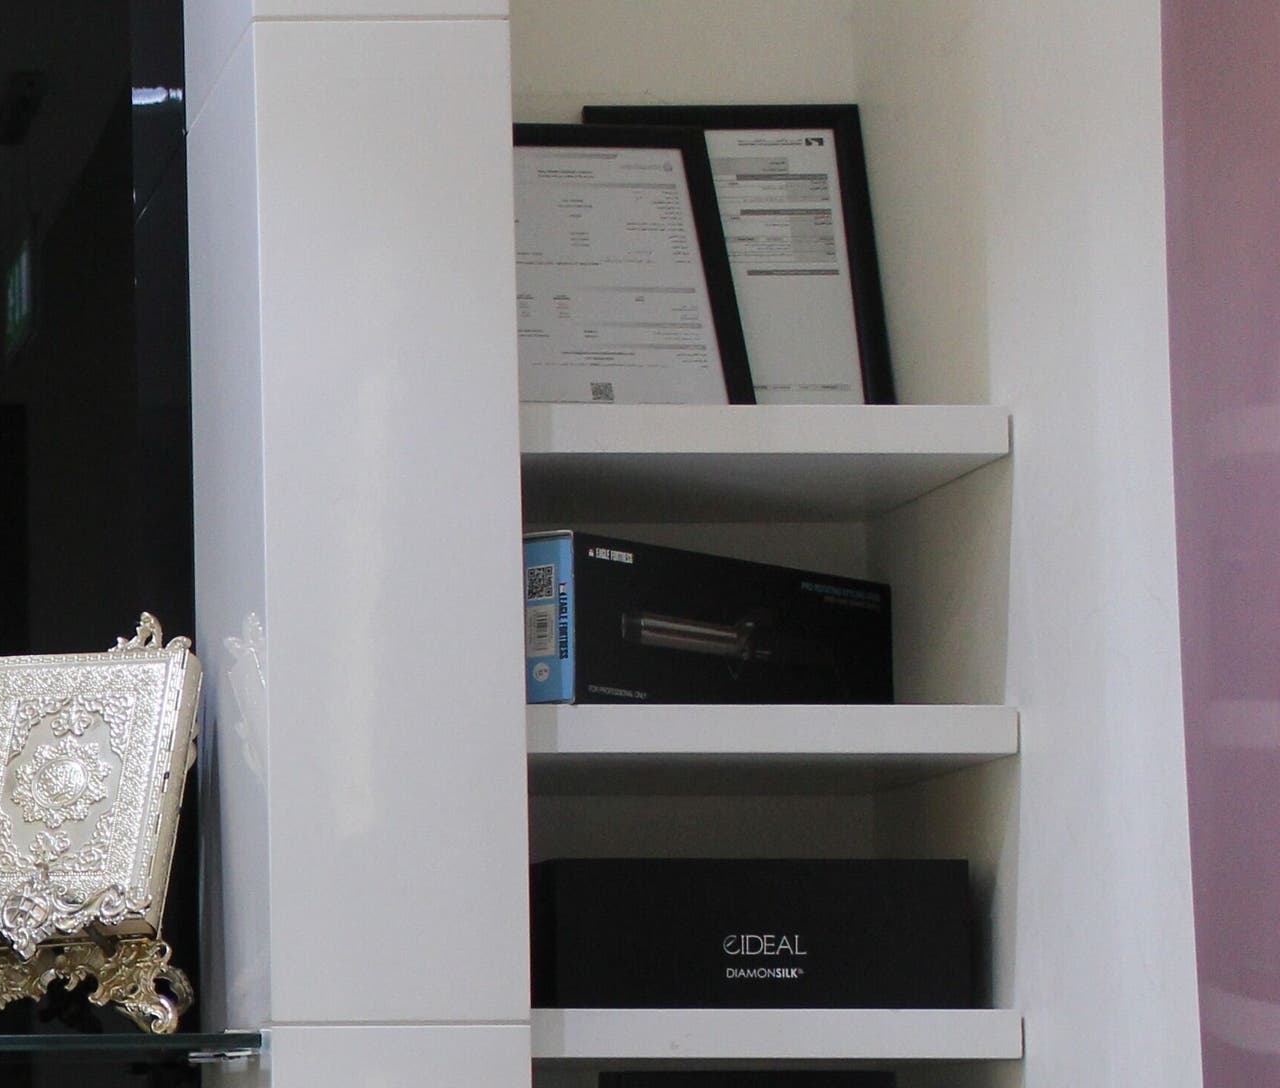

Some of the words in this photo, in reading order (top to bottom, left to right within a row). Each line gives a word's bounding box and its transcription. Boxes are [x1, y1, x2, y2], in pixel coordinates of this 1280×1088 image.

[595, 547, 609, 560] EAGLE
[559, 597, 568, 621] EAGLE
[559, 621, 569, 660] FORTRESS
